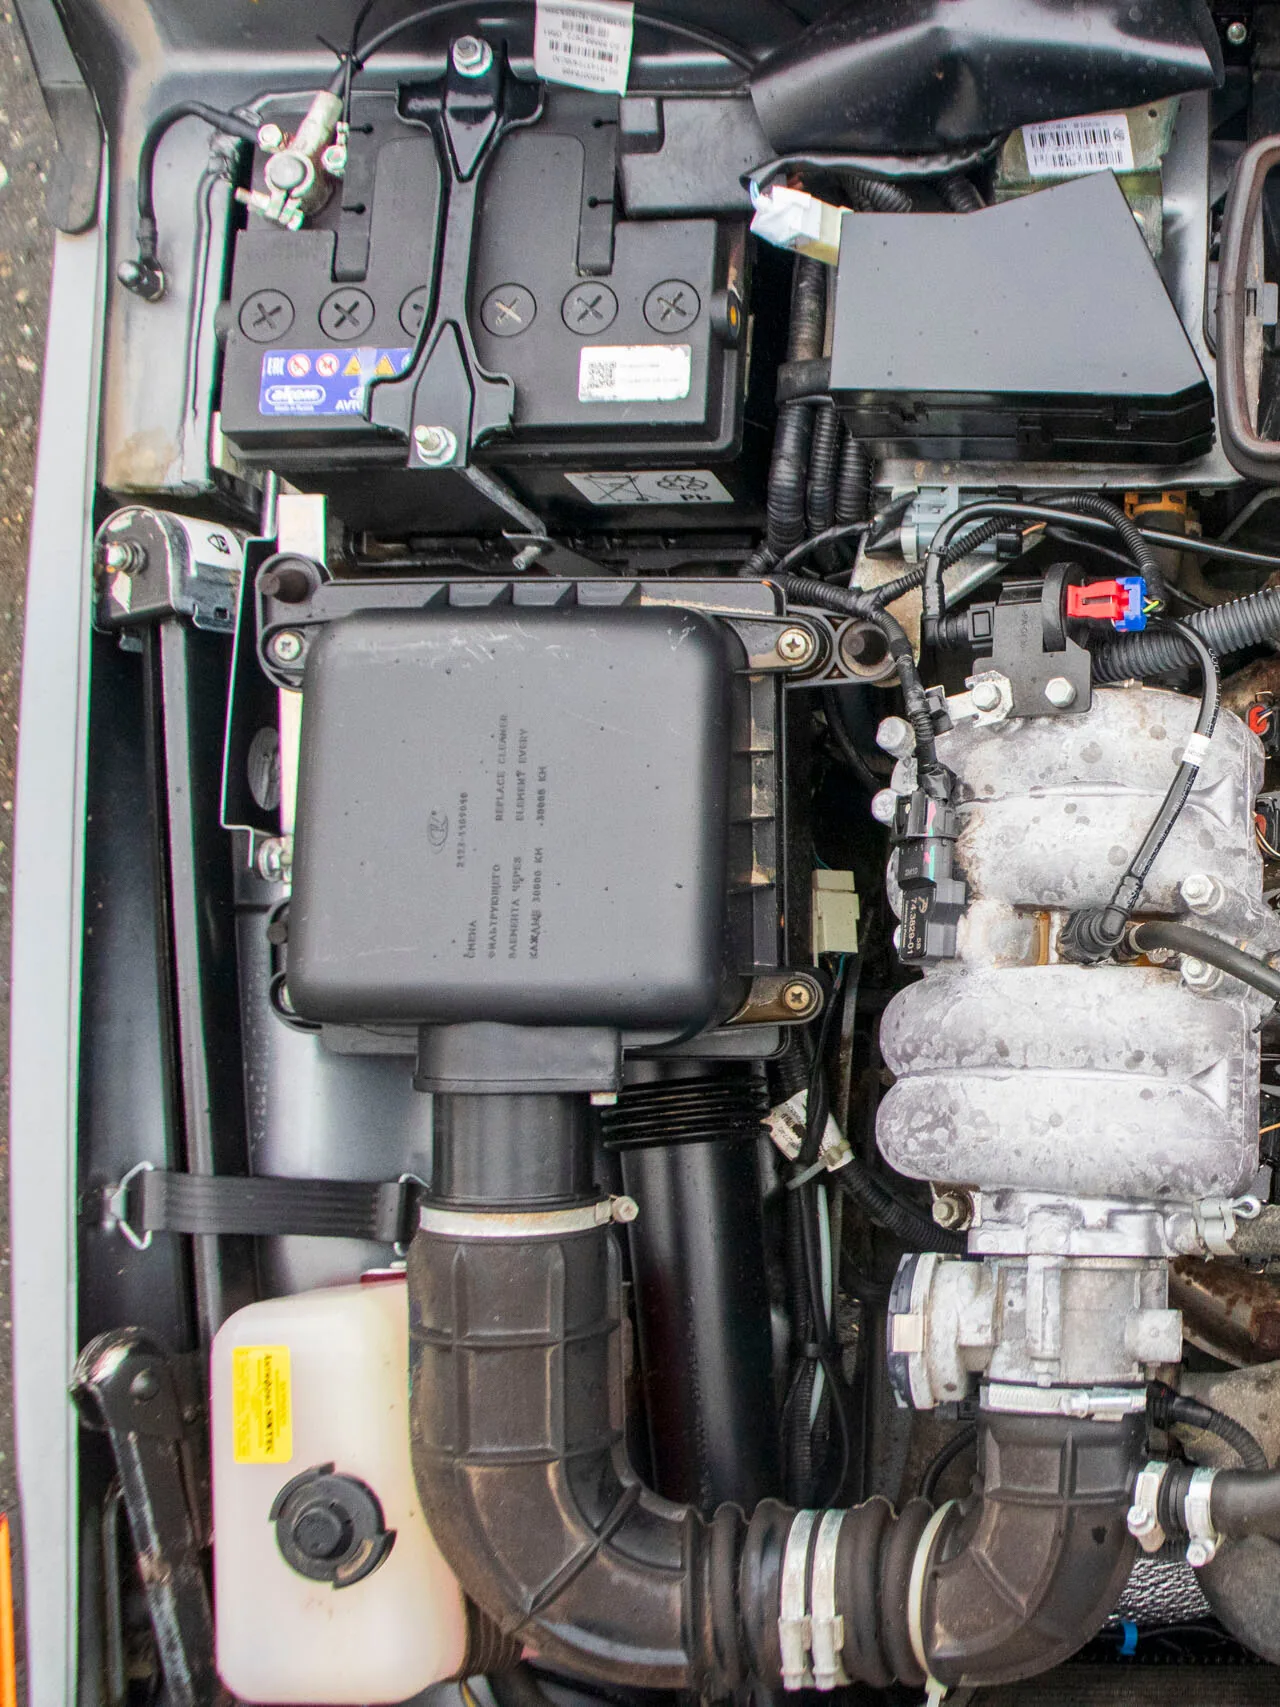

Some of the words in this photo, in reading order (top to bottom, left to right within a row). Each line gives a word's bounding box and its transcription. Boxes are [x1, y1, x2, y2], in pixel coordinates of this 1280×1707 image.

[680, 493, 711, 502] Pb
[496, 714, 508, 764] CLEANER
[517, 728, 529, 764] EVERY
[494, 771, 506, 822] REPLACE
[515, 770, 527, 821] ELEMENT
[465, 919, 478, 959] СМЕНА
[908, 898, 917, 955] 74.3829-01
